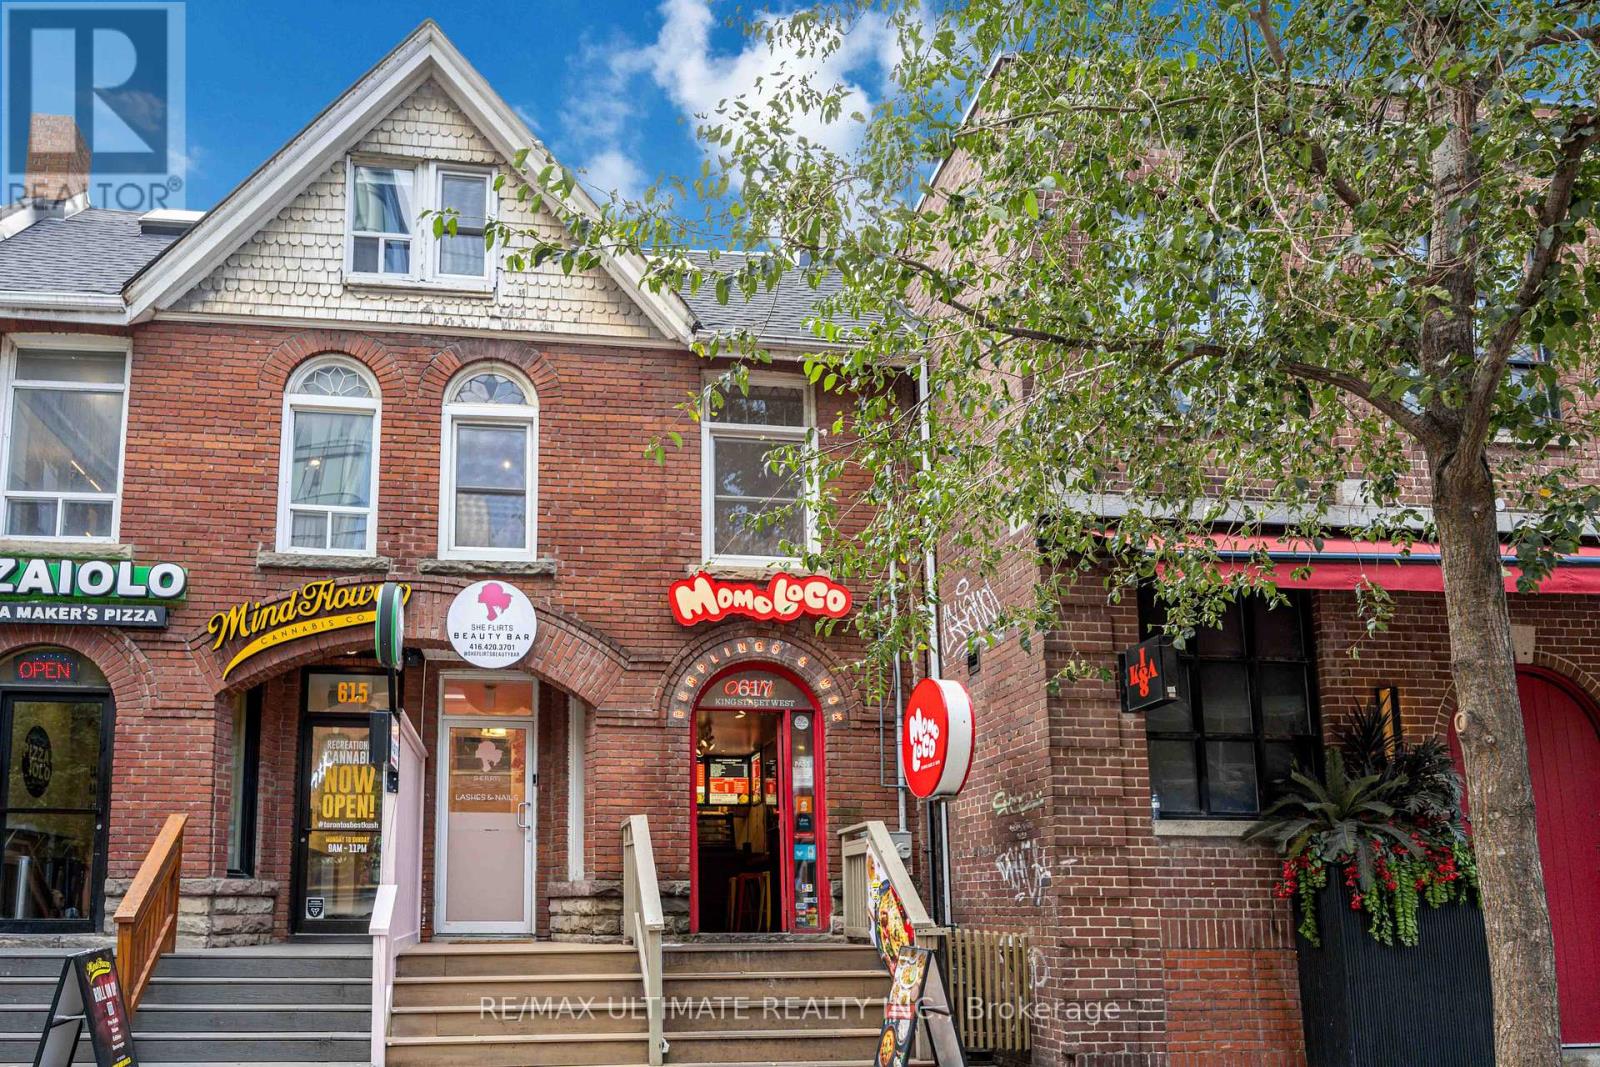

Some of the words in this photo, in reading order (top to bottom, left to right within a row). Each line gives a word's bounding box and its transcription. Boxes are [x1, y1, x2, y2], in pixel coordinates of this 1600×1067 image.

[16, 605, 98, 621] MAKER'S
[104, 608, 158, 622] PIZZA
[260, 619, 335, 646] CANNABIS
[471, 623, 486, 631] SHE
[487, 624, 514, 632] FLIRTS
[453, 632, 501, 640] BEAUTY
[506, 633, 530, 641] BAR
[469, 643, 515, 651] 416.420.3701
[19, 661, 71, 679] OPEN
[673, 641, 782, 719] DUMPLINGS
[819, 678, 843, 721] WOK
[337, 681, 369, 703] 615
[715, 698, 737, 707] KING
[738, 698, 769, 708] STREET
[771, 699, 795, 707] WEST
[328, 740, 370, 750] RECREATION
[327, 751, 370, 765] CANNABI
[324, 765, 376, 793] NOW
[322, 793, 375, 819] OPEN!
[328, 844, 343, 853] 9AM
[349, 844, 367, 853] 11PM
